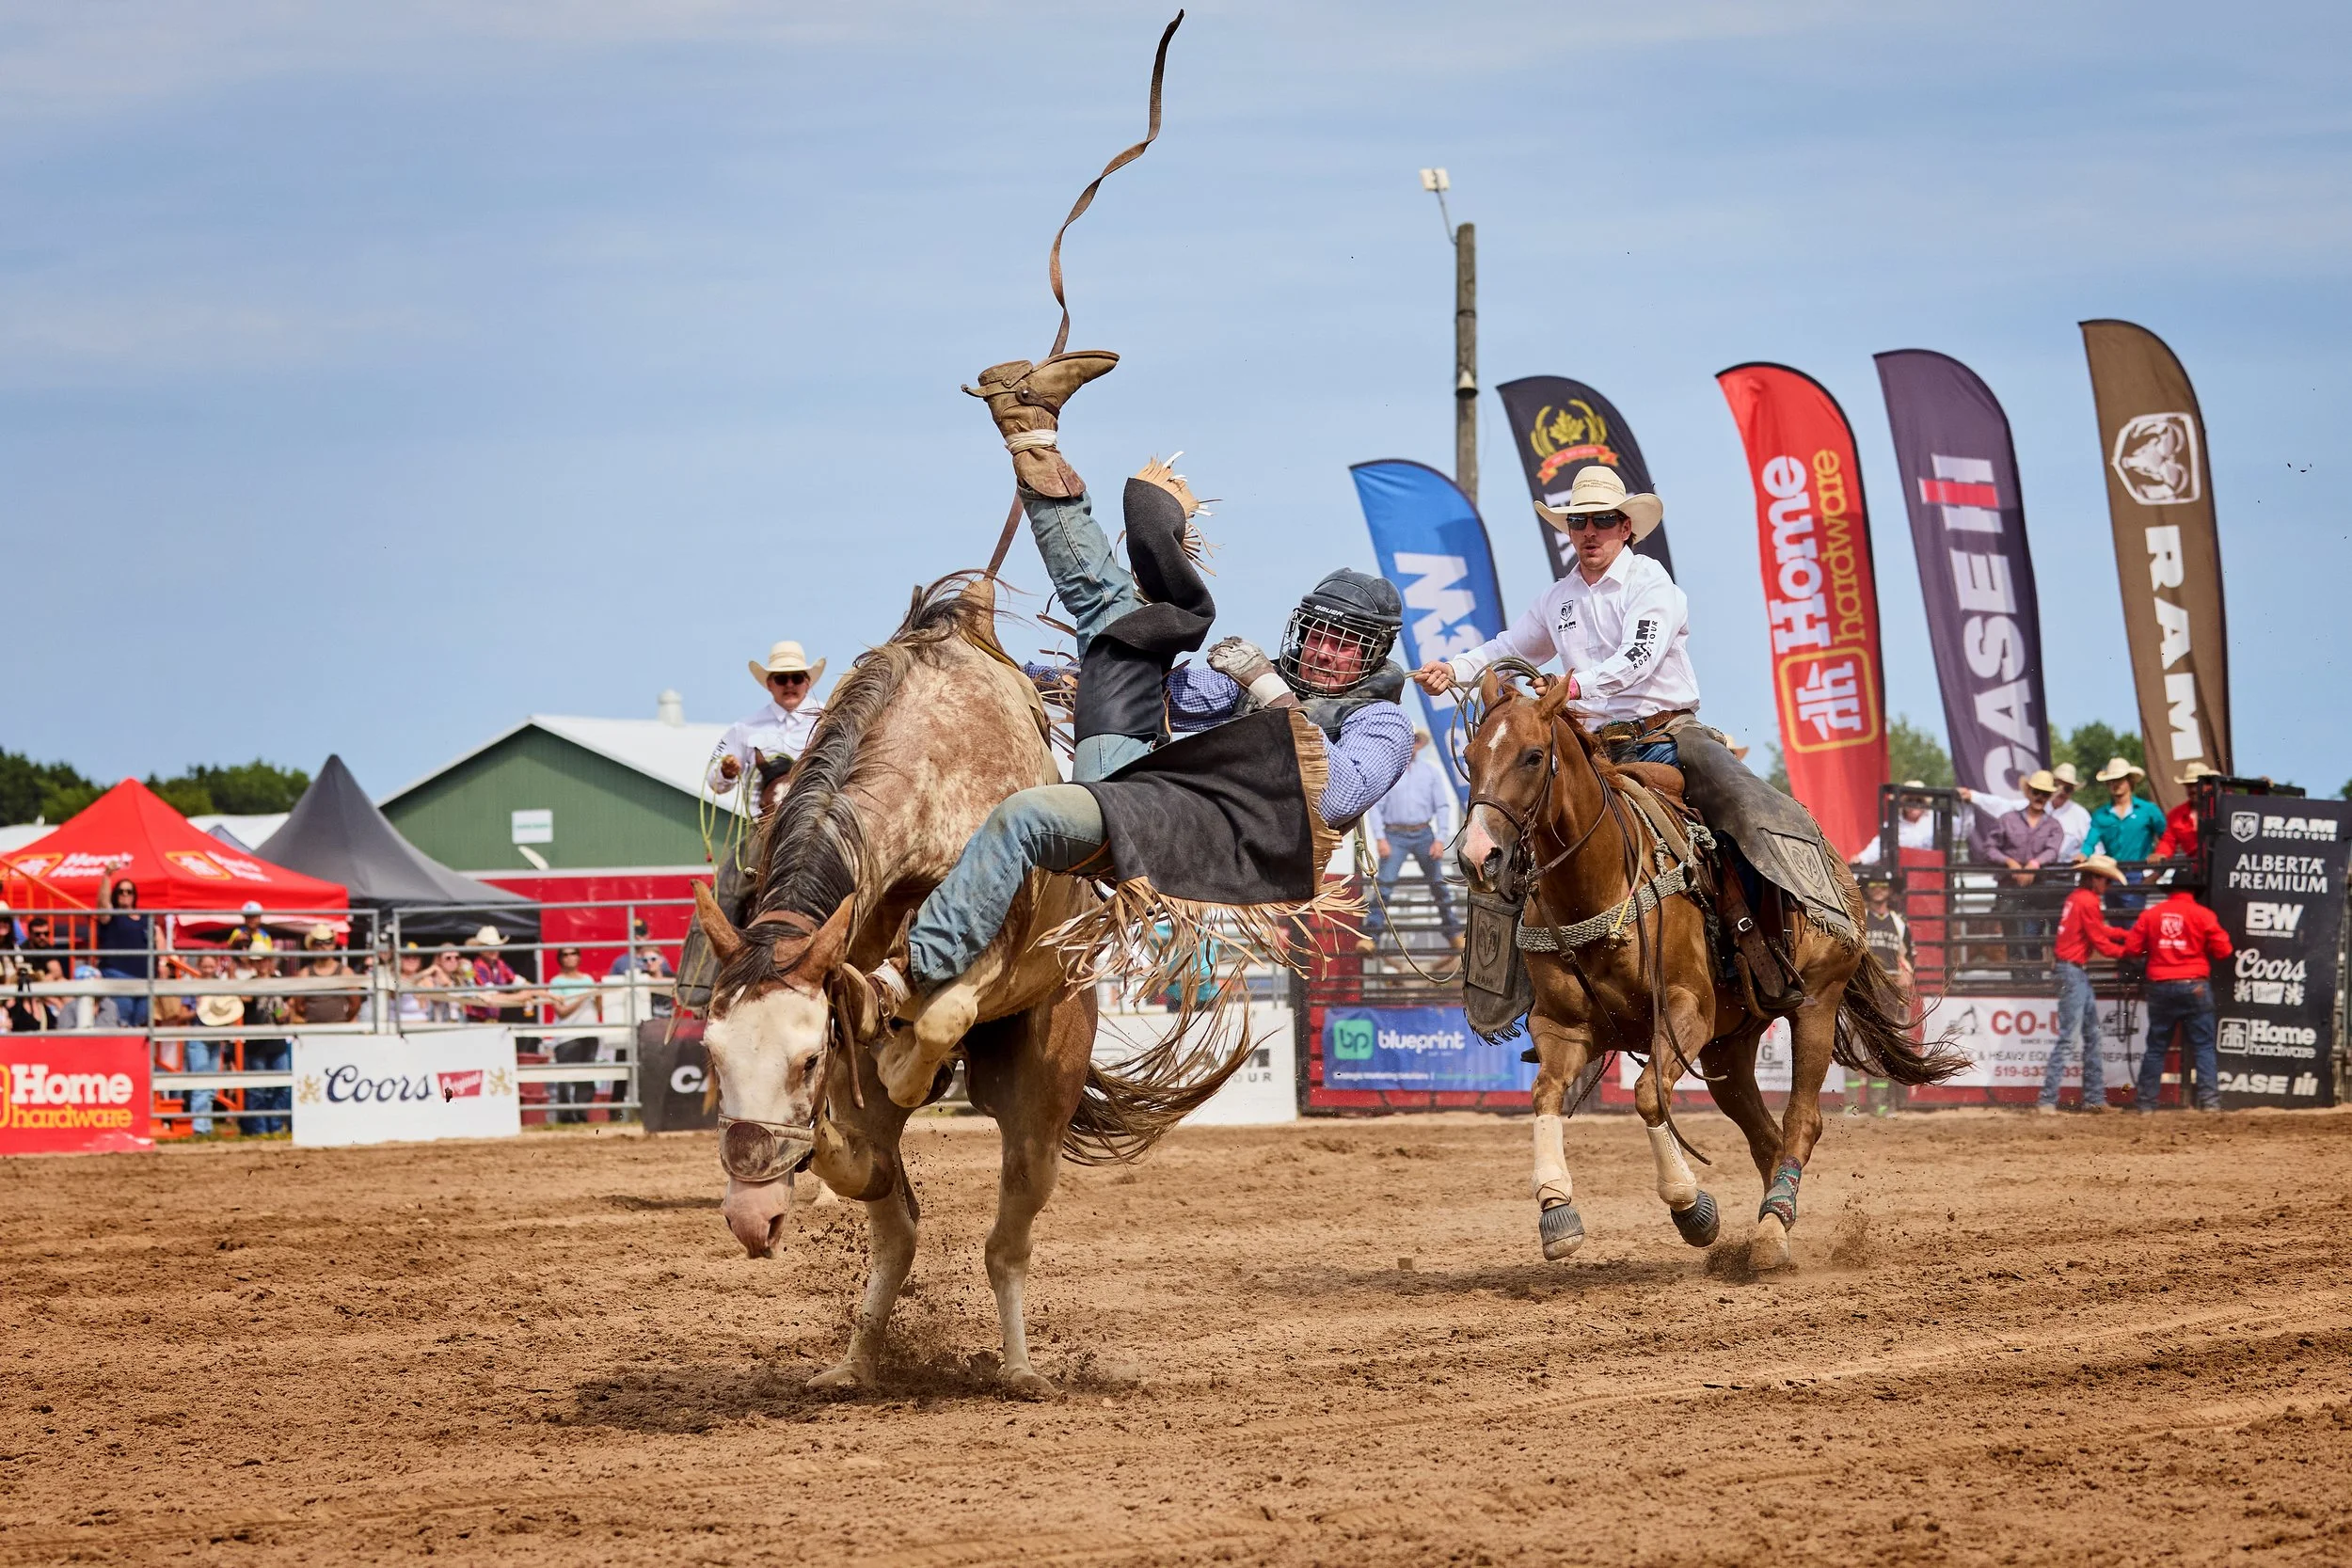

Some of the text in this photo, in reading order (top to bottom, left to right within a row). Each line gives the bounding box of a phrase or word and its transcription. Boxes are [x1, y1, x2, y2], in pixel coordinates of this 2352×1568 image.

[1761, 455, 1831, 654] Home
[1813, 449, 1867, 644] hardware
[1558, 621, 1577, 630] RAM
[1624, 620, 1651, 662] RAM
[2145, 525, 2204, 761] RAM
[1949, 548, 2048, 800] CASE
[2262, 829, 2337, 842] RODEO TOUR
[2263, 816, 2338, 833] RAM
[2235, 853, 2326, 876] ALBERTA
[2229, 871, 2328, 895] PREMIUM
[2234, 948, 2307, 981] Coors
[1377, 1030, 1466, 1053] blueprint
[2249, 1019, 2317, 1046] Home
[2249, 1042, 2317, 1059] hardware
[10, 1063, 135, 1105] Home
[325, 1064, 434, 1103] Coors
[2217, 1070, 2289, 1095] CASE
[10, 1102, 135, 1129] hardware
